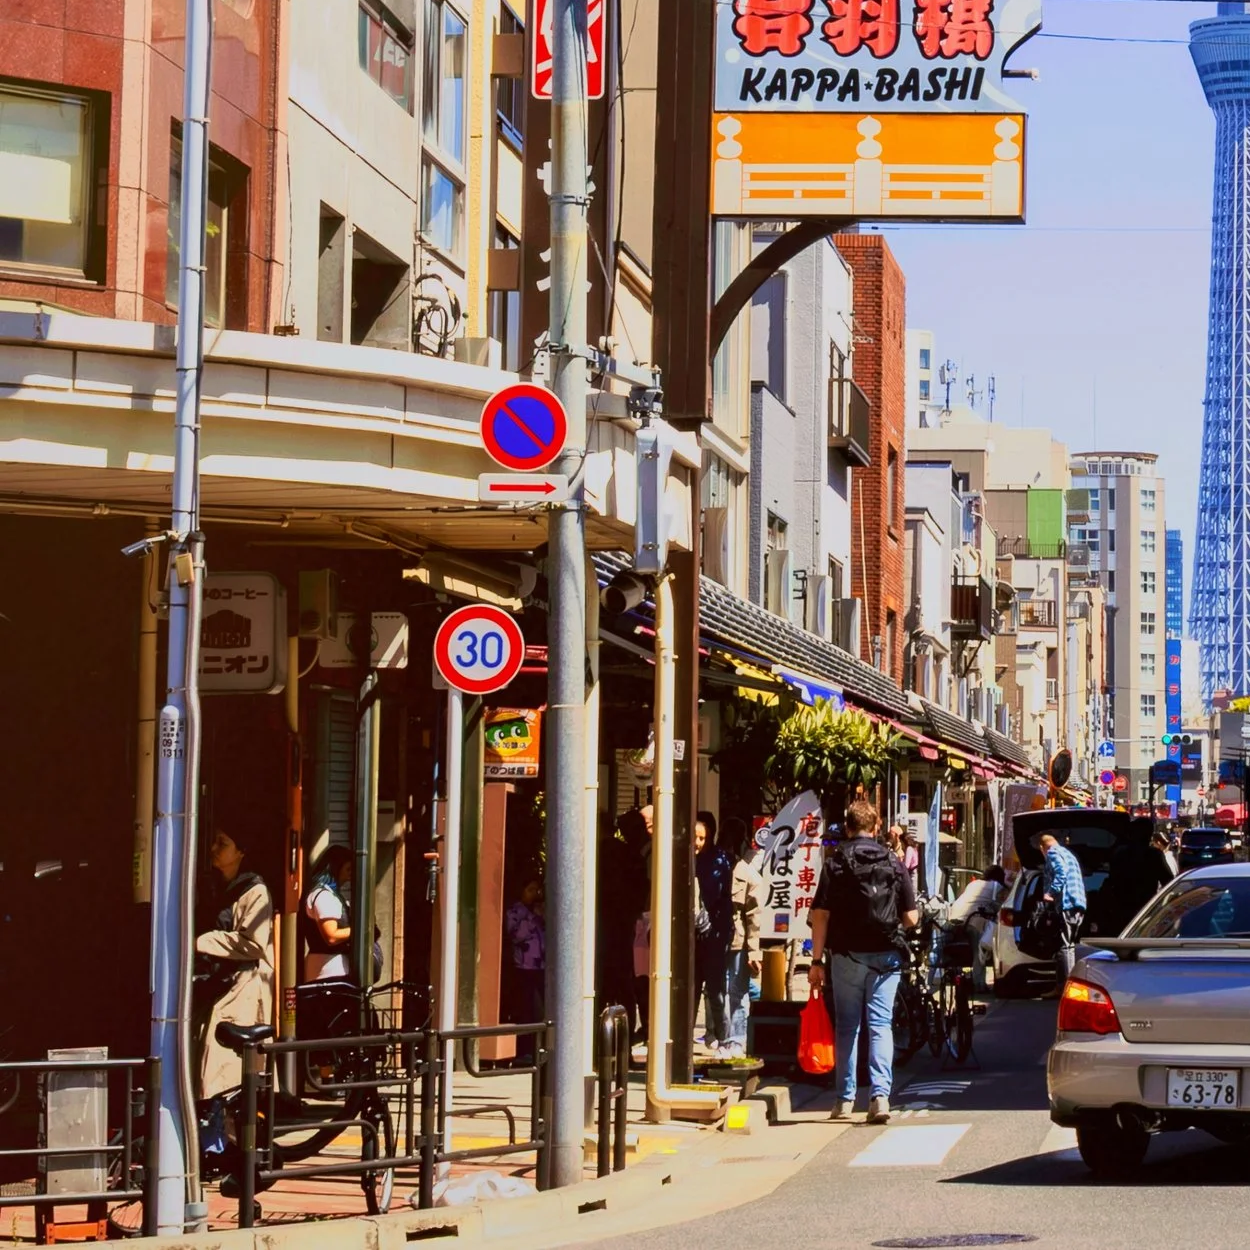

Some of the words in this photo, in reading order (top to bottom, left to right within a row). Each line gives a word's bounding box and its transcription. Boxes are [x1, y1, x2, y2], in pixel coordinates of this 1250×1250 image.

[455, 631, 504, 668] 30
[198, 655, 269, 674] ニオン
[765, 825, 796, 910] つば屋
[1206, 1072, 1224, 1082] 330
[1182, 1084, 1235, 1104] 63-78
